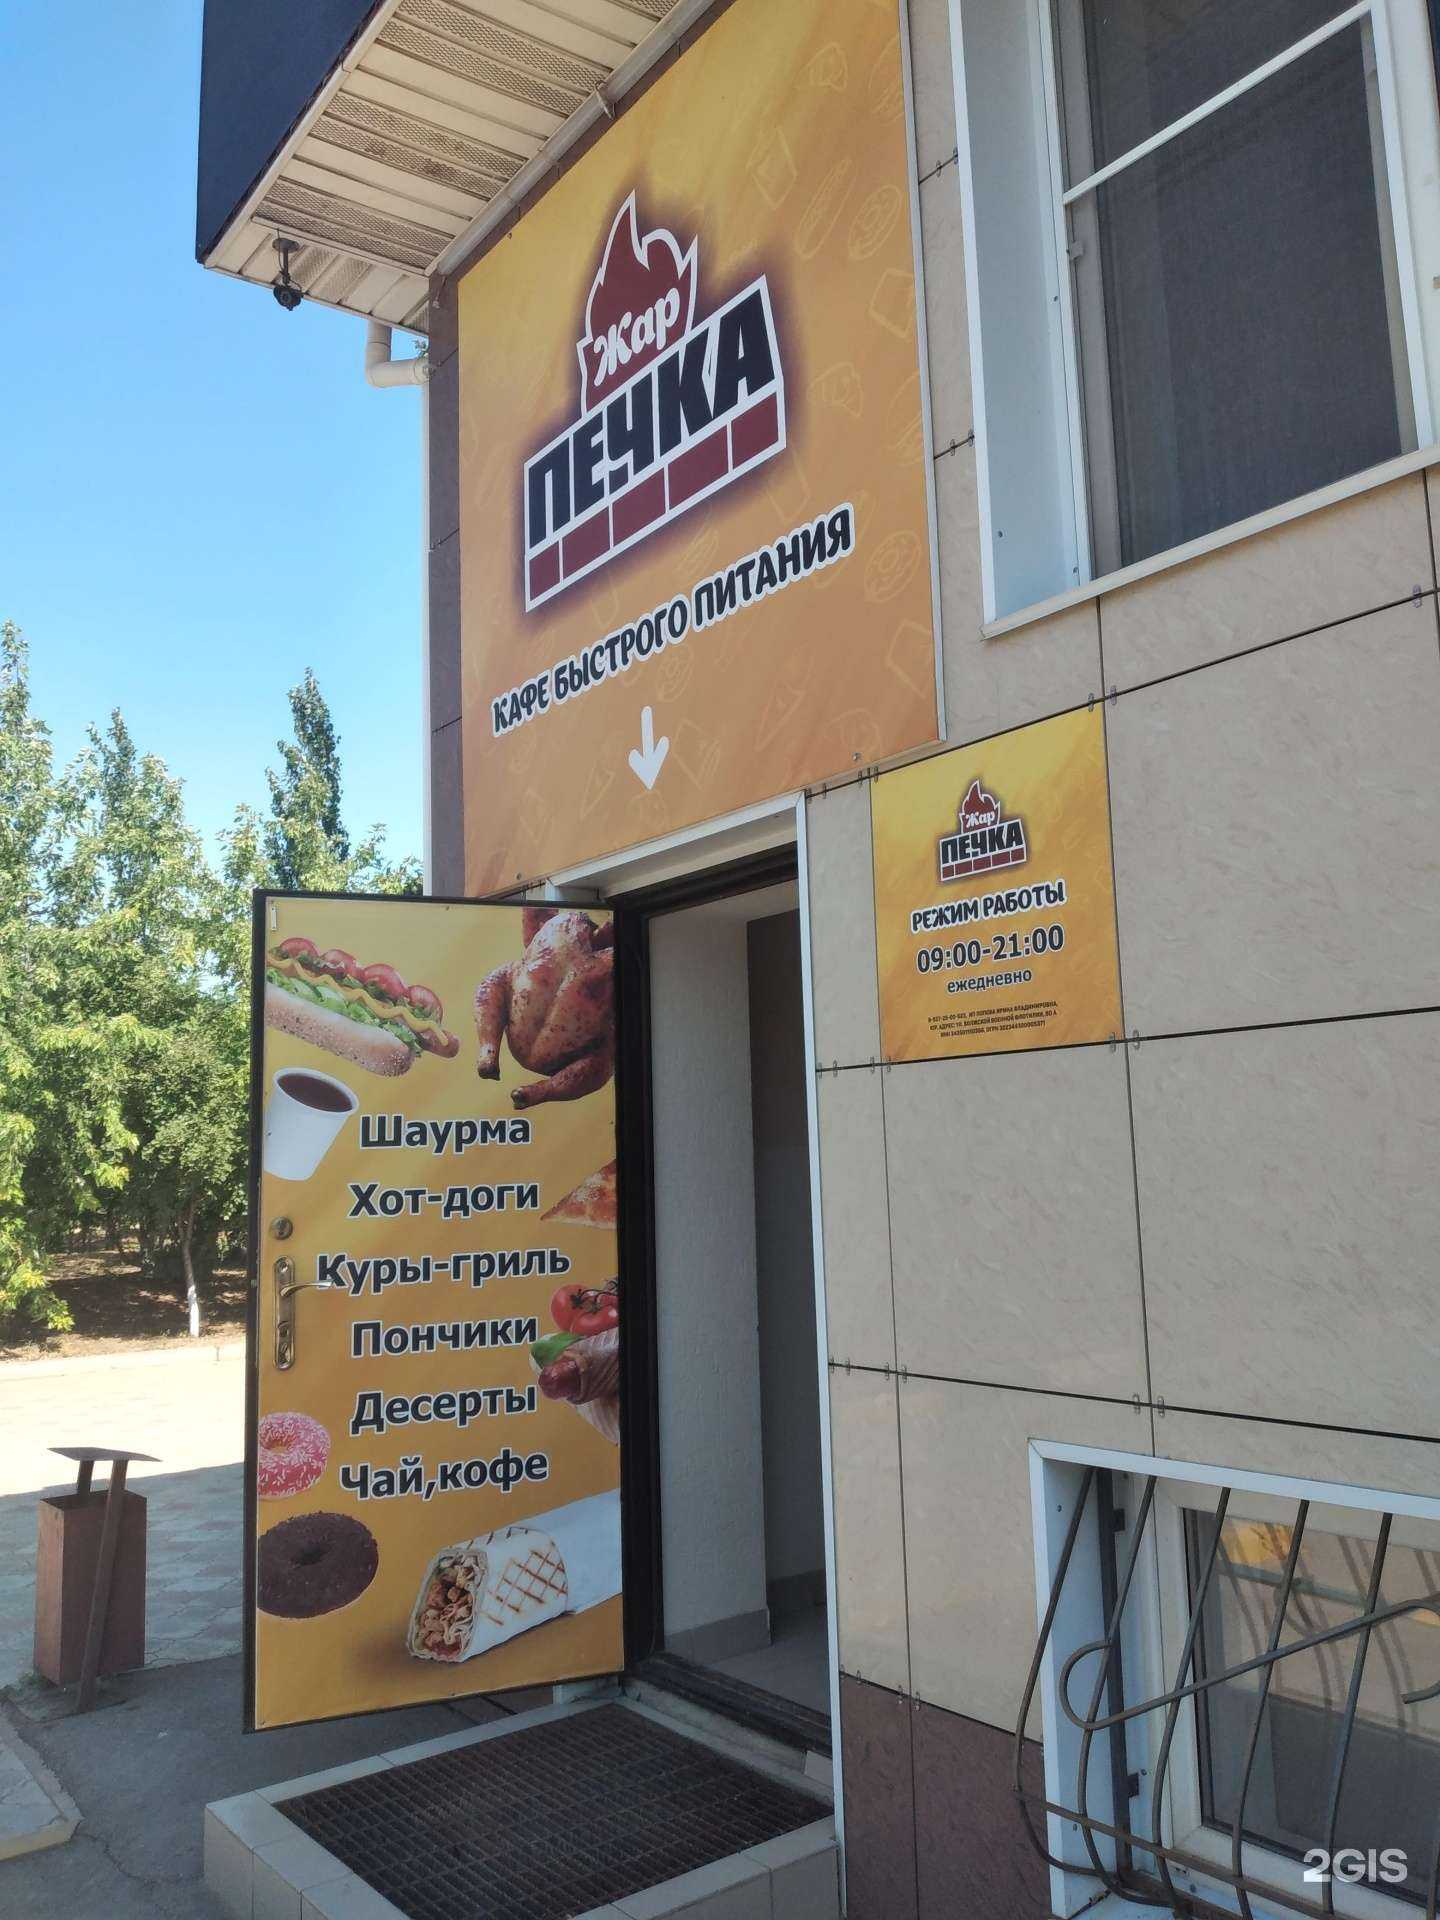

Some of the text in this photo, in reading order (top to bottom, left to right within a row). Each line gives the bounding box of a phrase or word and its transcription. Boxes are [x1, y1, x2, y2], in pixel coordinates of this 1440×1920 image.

[593, 287, 680, 387] Жар
[528, 288, 777, 550] ПЕЧКА
[492, 508, 852, 733] КАФЕ БЫСТРОГО ПИТАНИЯ
[965, 810, 996, 829] Жар
[941, 823, 1024, 865] ПЕЧКА
[912, 881, 1065, 932] РЕЖИМ РАБОТЫ
[917, 925, 1064, 973] 09:00-21:00
[947, 969, 1032, 993] ежедневно
[360, 1114, 531, 1154] Шаурма
[348, 1183, 539, 1218] Хот-доги
[317, 1249, 571, 1295] Куры-гриль
[352, 1317, 537, 1357] Пончики
[350, 1386, 537, 1435] Десерты
[341, 1449, 548, 1500] Чай,кофе
